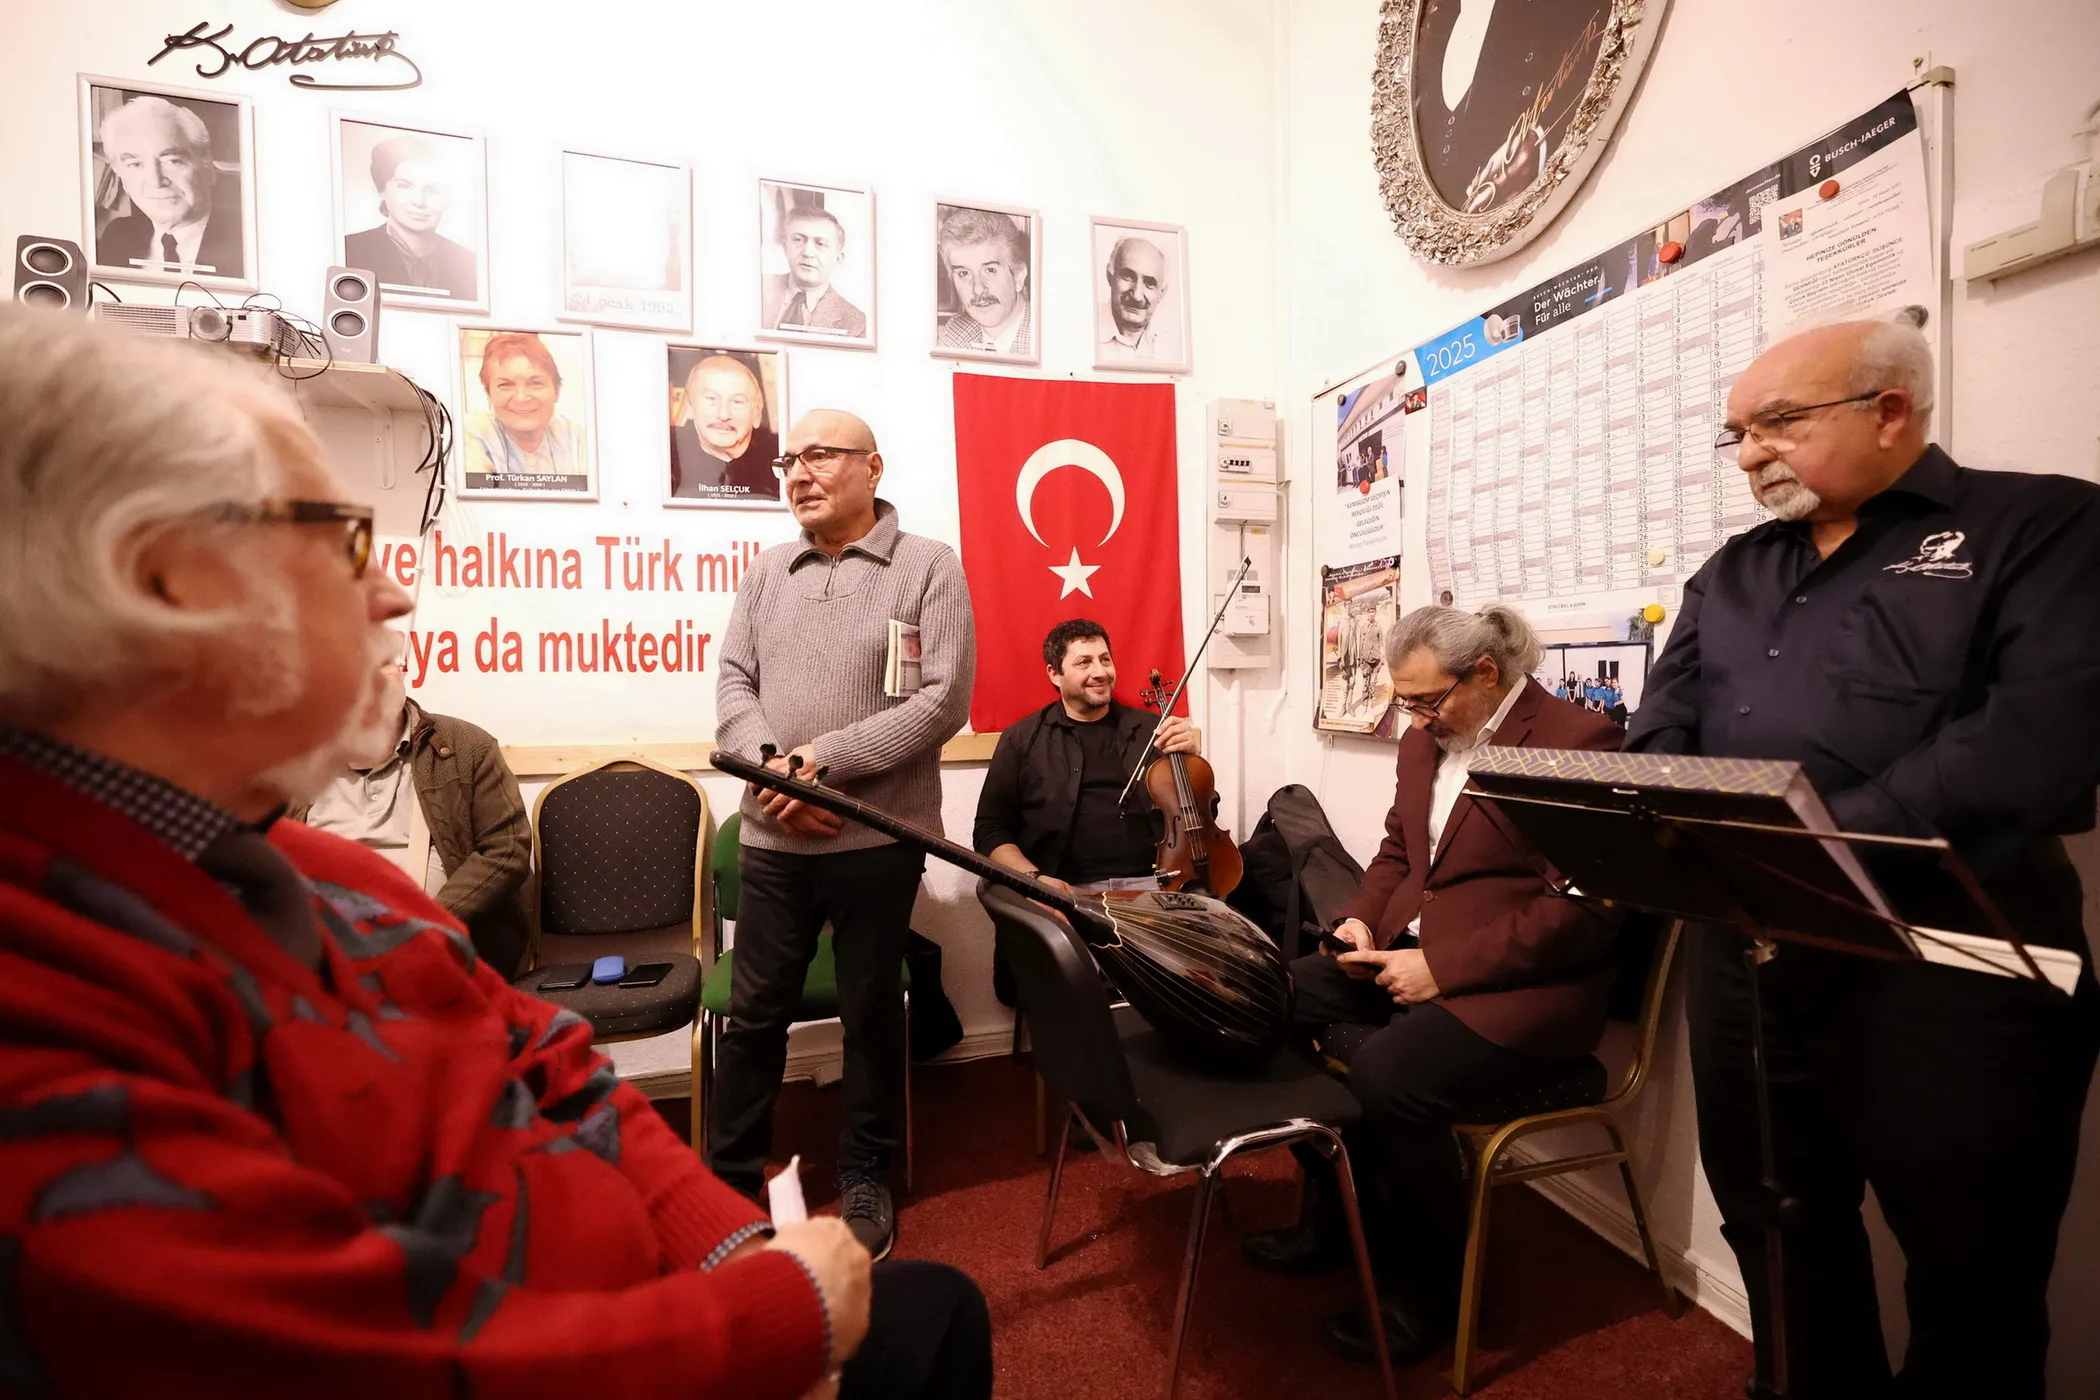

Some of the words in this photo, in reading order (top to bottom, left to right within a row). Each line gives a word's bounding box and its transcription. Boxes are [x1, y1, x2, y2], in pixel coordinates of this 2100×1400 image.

[1824, 117, 1896, 163] BUSCH-JAEGER
[1534, 298, 1551, 313] Der
[1553, 275, 1601, 303] Wächter.
[1714, 301, 1719, 310] 4
[1535, 311, 1551, 326] Für
[1552, 302, 1571, 318] alle
[1714, 311, 1719, 320] 5
[1714, 321, 1719, 329] 6
[1714, 331, 1719, 339] 7
[1714, 341, 1719, 349] 8
[1426, 333, 1476, 377] 2025
[1714, 351, 1719, 359] 9
[1713, 361, 1721, 369] 10
[1675, 374, 1681, 382] 10
[1713, 371, 1720, 379] 11
[1675, 384, 1680, 392] 11
[1713, 381, 1721, 389] 12
[1675, 393, 1682, 401] 12
[1713, 390, 1721, 399] 13
[1675, 403, 1682, 411] 13
[1713, 400, 1721, 409] 14
[1675, 412, 1682, 420] 14
[1713, 410, 1722, 419] 15
[1675, 422, 1682, 430] 15
[1713, 420, 1722, 428] 16
[1675, 431, 1682, 439] 16
[1675, 441, 1682, 449] 17
[1675, 450, 1683, 458] 18
[1675, 460, 1683, 468] 19
[1713, 460, 1722, 468] 20
[1675, 469, 1683, 477] 20
[1713, 470, 1721, 478] 21
[485, 473, 505, 481] Prof.
[506, 473, 535, 482] Türkan
[536, 474, 568, 483] SAYLAN
[1675, 479, 1682, 487] 21
[1714, 480, 1722, 488] 22
[698, 482, 719, 492] İlhan
[720, 485, 751, 495] SELÇUK
[1675, 488, 1683, 496] 22
[1714, 490, 1722, 498] 23
[1676, 498, 1683, 506] 23
[1714, 500, 1722, 508] 24
[1676, 507, 1684, 516] 24
[1714, 510, 1722, 518] 25
[1676, 517, 1684, 525] 25
[1714, 520, 1723, 528] 26
[1676, 526, 1684, 535] 26
[1714, 530, 1723, 538] 27
[1676, 536, 1684, 544] 27
[1714, 540, 1723, 548] 28
[1676, 546, 1684, 554] 28
[435, 530, 583, 590] halkına
[596, 536, 684, 592] Türk
[697, 541, 760, 592] mil
[1676, 555, 1684, 563] 29
[1676, 565, 1685, 573] 30
[402, 630, 460, 688] ya
[475, 617, 523, 673] da
[539, 618, 712, 673] muktedir
